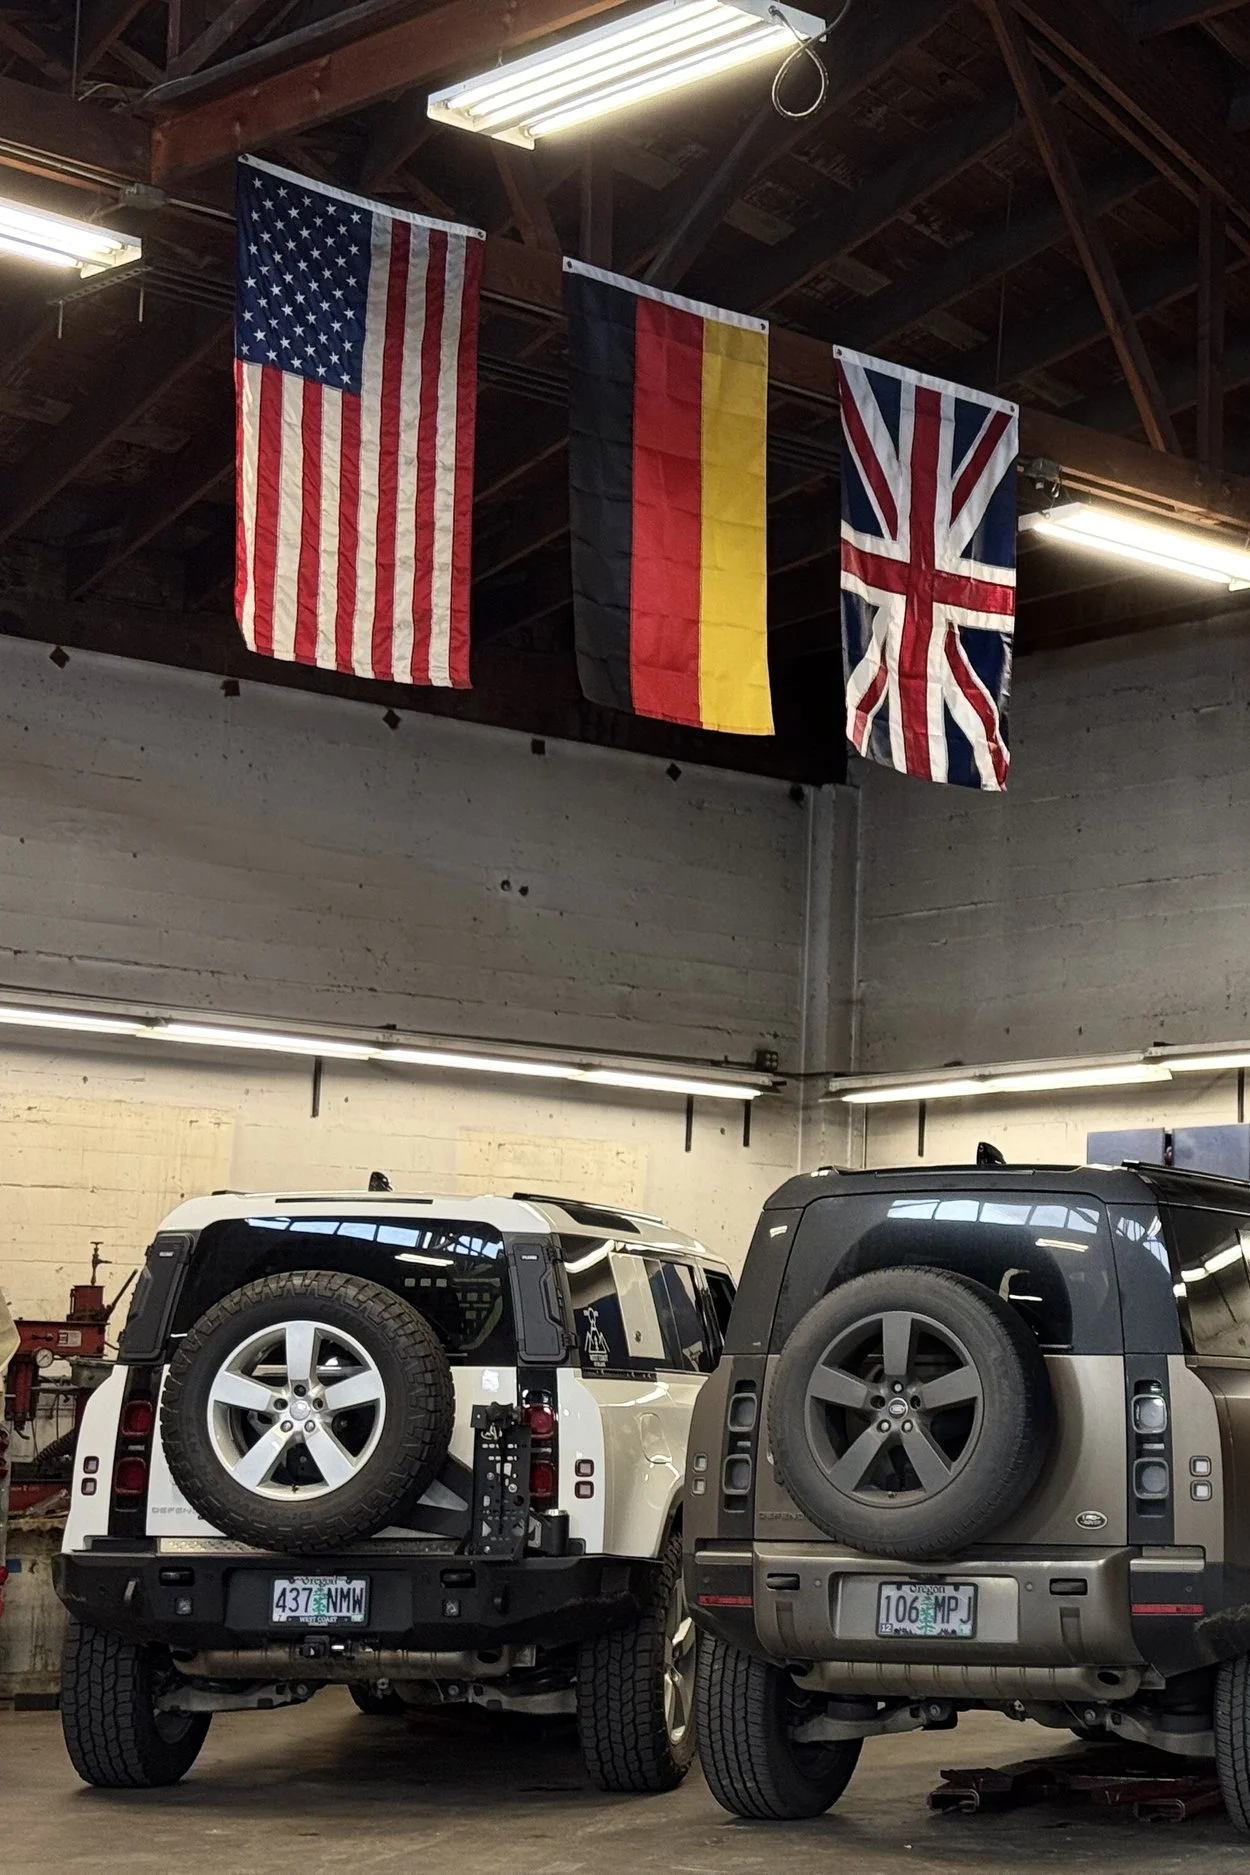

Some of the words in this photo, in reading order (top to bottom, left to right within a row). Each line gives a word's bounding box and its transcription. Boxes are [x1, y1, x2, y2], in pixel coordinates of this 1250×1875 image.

[910, 1585, 946, 1595] Oregon
[275, 1587, 313, 1613] 437
[326, 1587, 364, 1613] NMW
[885, 1595, 920, 1623] 106
[934, 1595, 972, 1623] MPJ
[881, 1624, 891, 1632] 12
